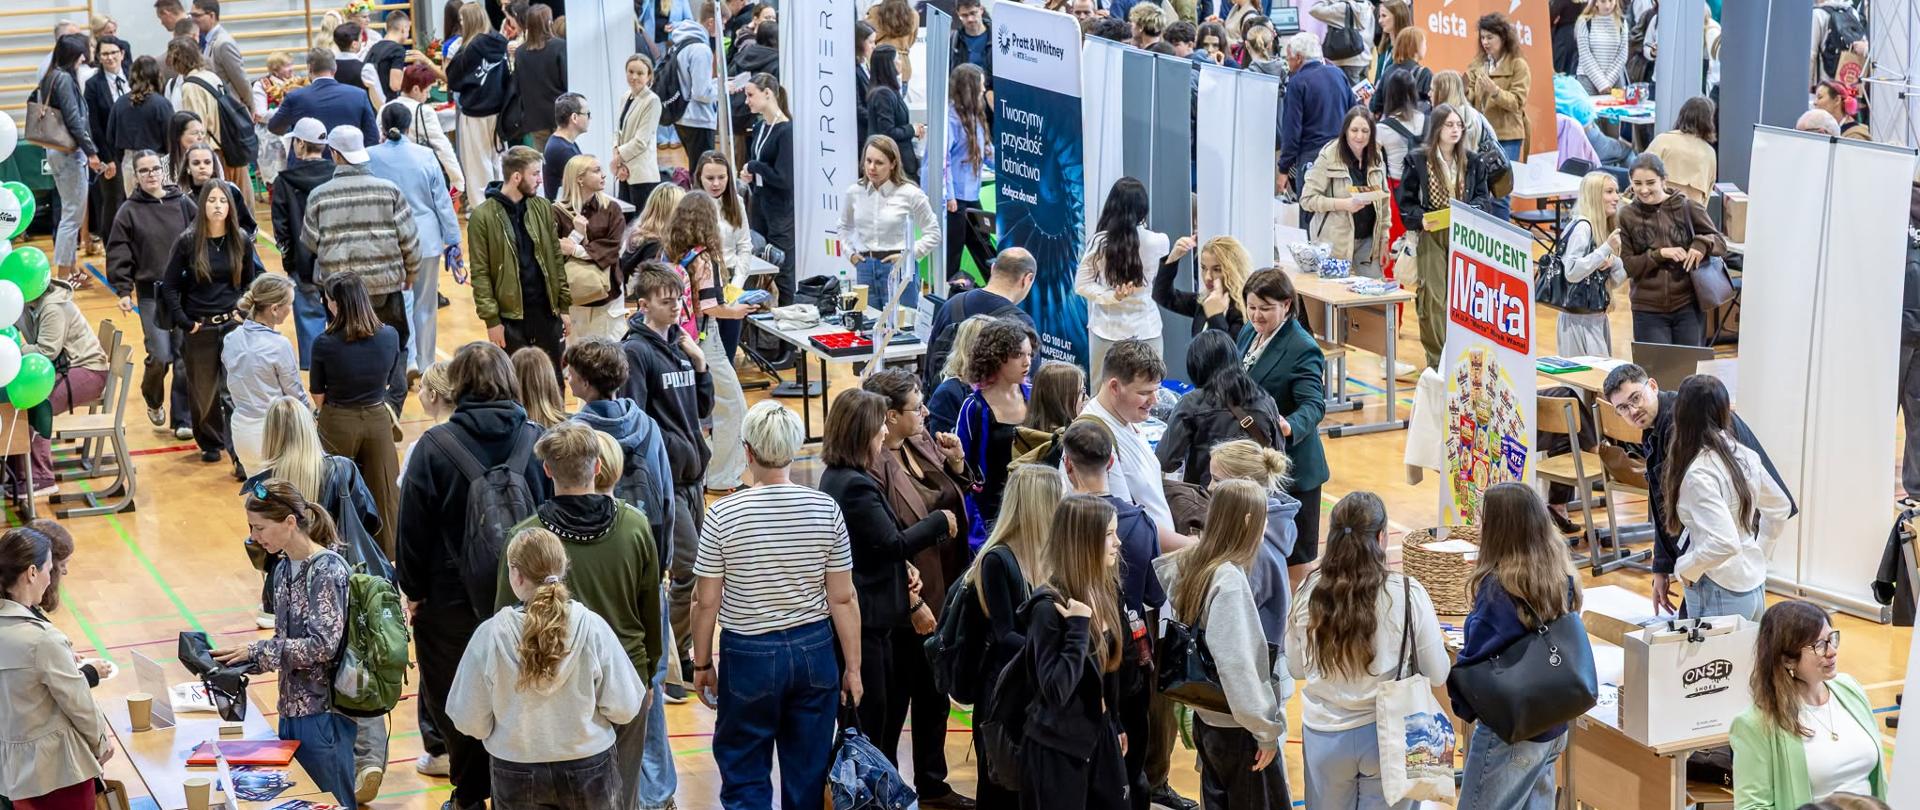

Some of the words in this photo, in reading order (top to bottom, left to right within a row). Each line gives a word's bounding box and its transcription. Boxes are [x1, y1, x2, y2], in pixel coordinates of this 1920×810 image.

[1428, 10, 1467, 38] elsta
[1012, 33, 1029, 50] Pratt
[1030, 39, 1035, 51] &
[1035, 38, 1064, 60] Whitney
[1000, 99, 1043, 133] Tworzymy
[1001, 132, 1043, 156] przyszłość
[1001, 151, 1040, 181] lotnictwa
[1019, 188, 1026, 200] do
[1453, 221, 1527, 273] PRODUCENT
[1452, 256, 1526, 340] Marta
[1042, 333, 1051, 343] OD
[1052, 337, 1060, 347] 100
[1061, 339, 1072, 350] LAT
[1685, 661, 1731, 682] ONSET
